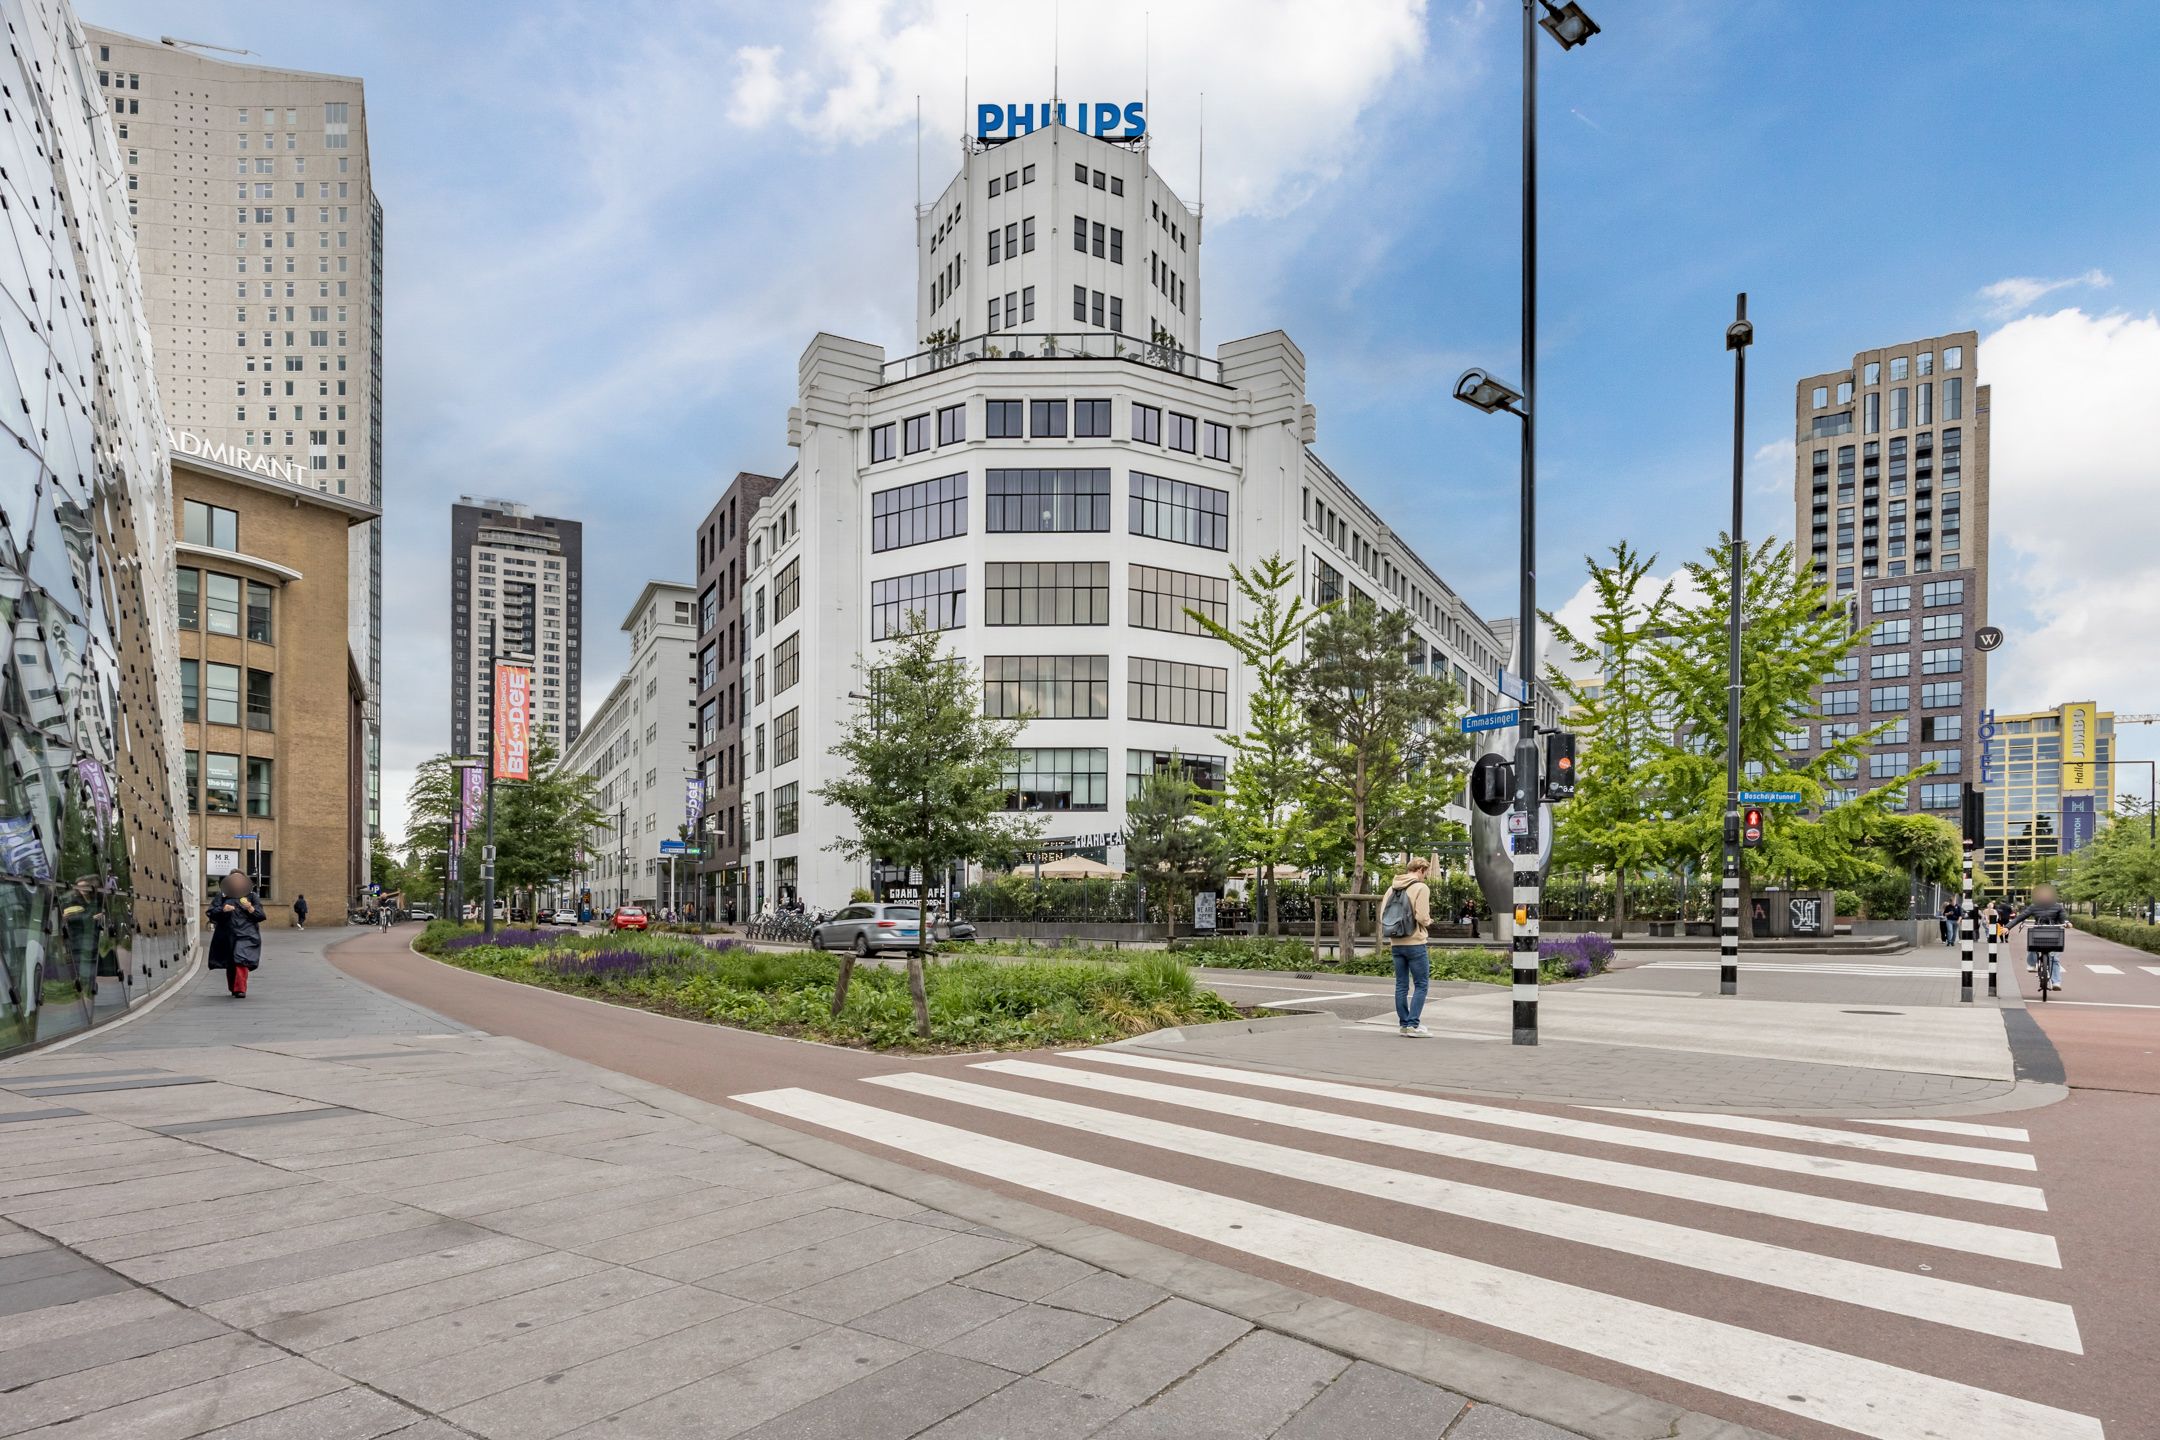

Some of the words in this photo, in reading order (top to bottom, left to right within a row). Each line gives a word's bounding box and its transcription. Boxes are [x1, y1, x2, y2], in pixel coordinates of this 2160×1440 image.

[978, 102, 1147, 138] PHILIPS
[167, 426, 308, 485] ADMIRANT
[1980, 633, 1997, 645] W
[1466, 712, 1514, 728] Emmasingel
[2071, 708, 2086, 758] JUMBO
[1978, 709, 1995, 783] HOTEL
[1744, 793, 1796, 801] Boschdijktunnel
[1075, 833, 1105, 848] GRAND
[1026, 852, 1063, 862] TOREN
[890, 888, 918, 899] GRAND
